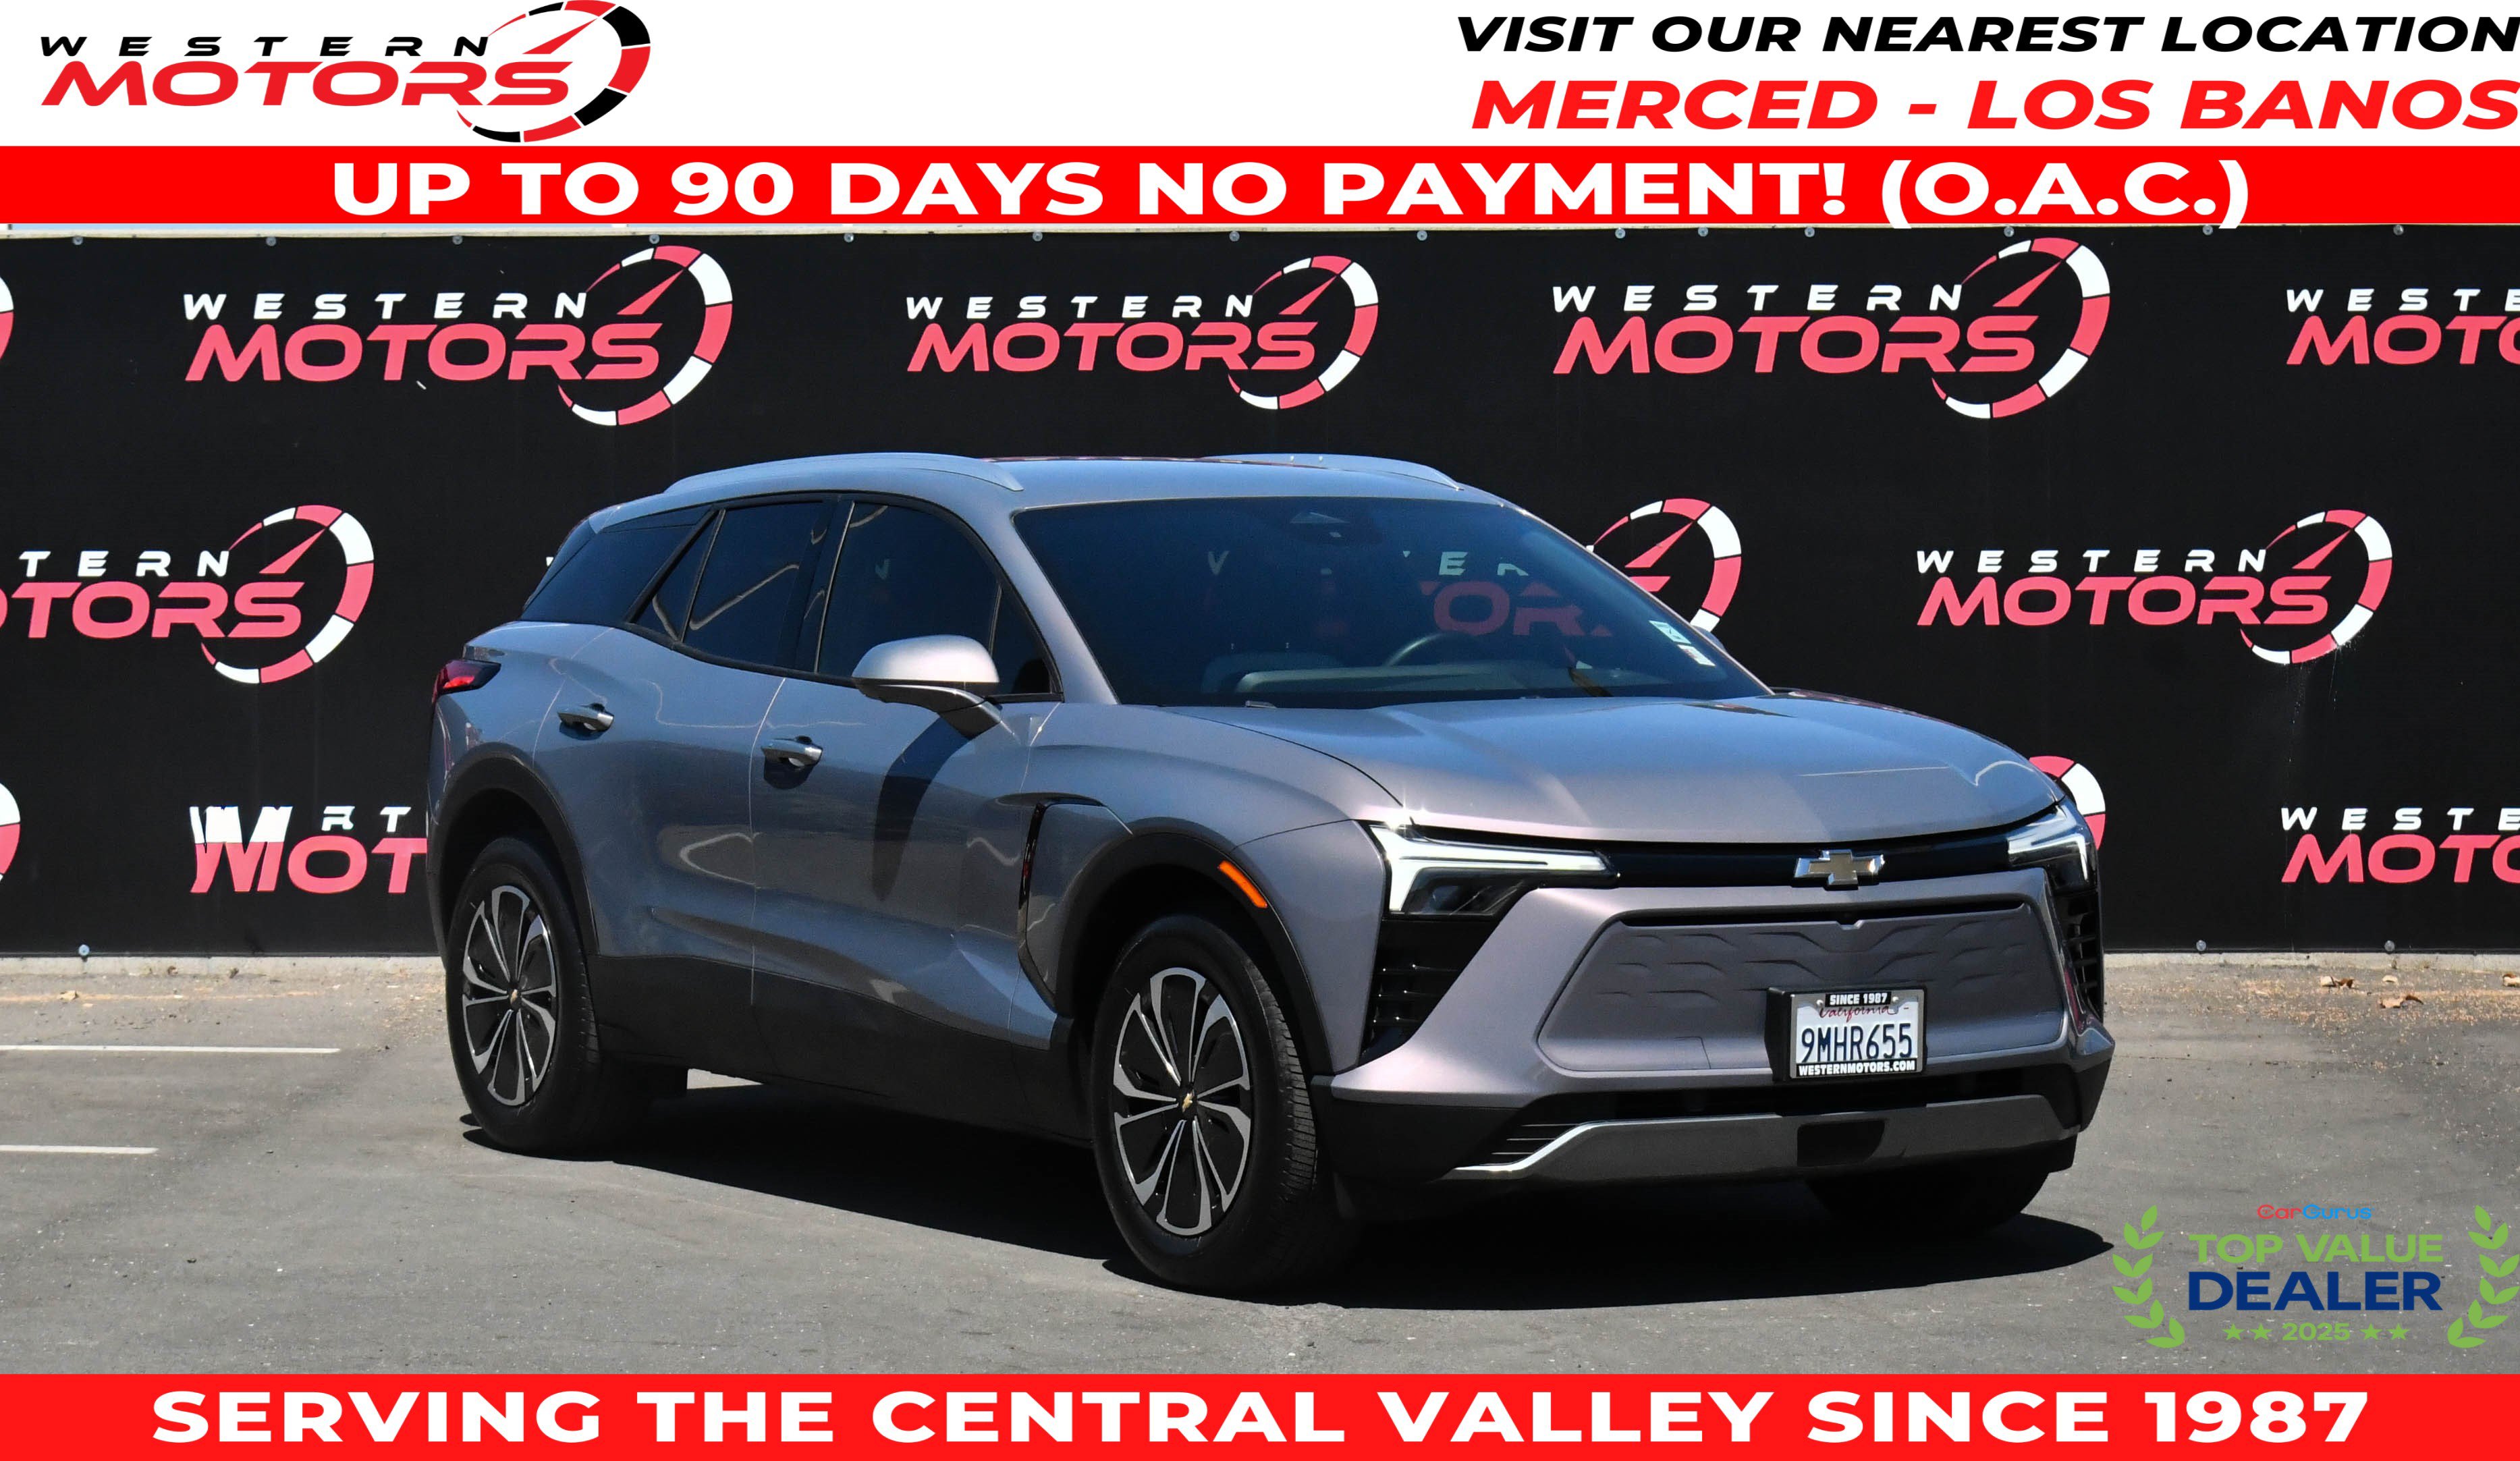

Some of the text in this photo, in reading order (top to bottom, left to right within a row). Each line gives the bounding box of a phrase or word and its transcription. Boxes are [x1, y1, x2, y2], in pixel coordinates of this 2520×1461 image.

[184, 293, 586, 320] WESTERN
[907, 295, 1253, 319] WESTERN
[1553, 285, 1962, 312] WESTERN
[186, 323, 662, 381] MOTORS
[908, 322, 1317, 372] MOTORS
[1554, 316, 2038, 374] MOTORS
[1917, 549, 2266, 573] WESTERN
[0, 581, 304, 638] TORS
[1918, 576, 2331, 626] MOTORS
[1830, 992, 1888, 1005] SINCE 1987
[1801, 1022, 1912, 1063] 9MHR655
[1799, 1060, 1915, 1076] WESTERNMOTORS.COM
